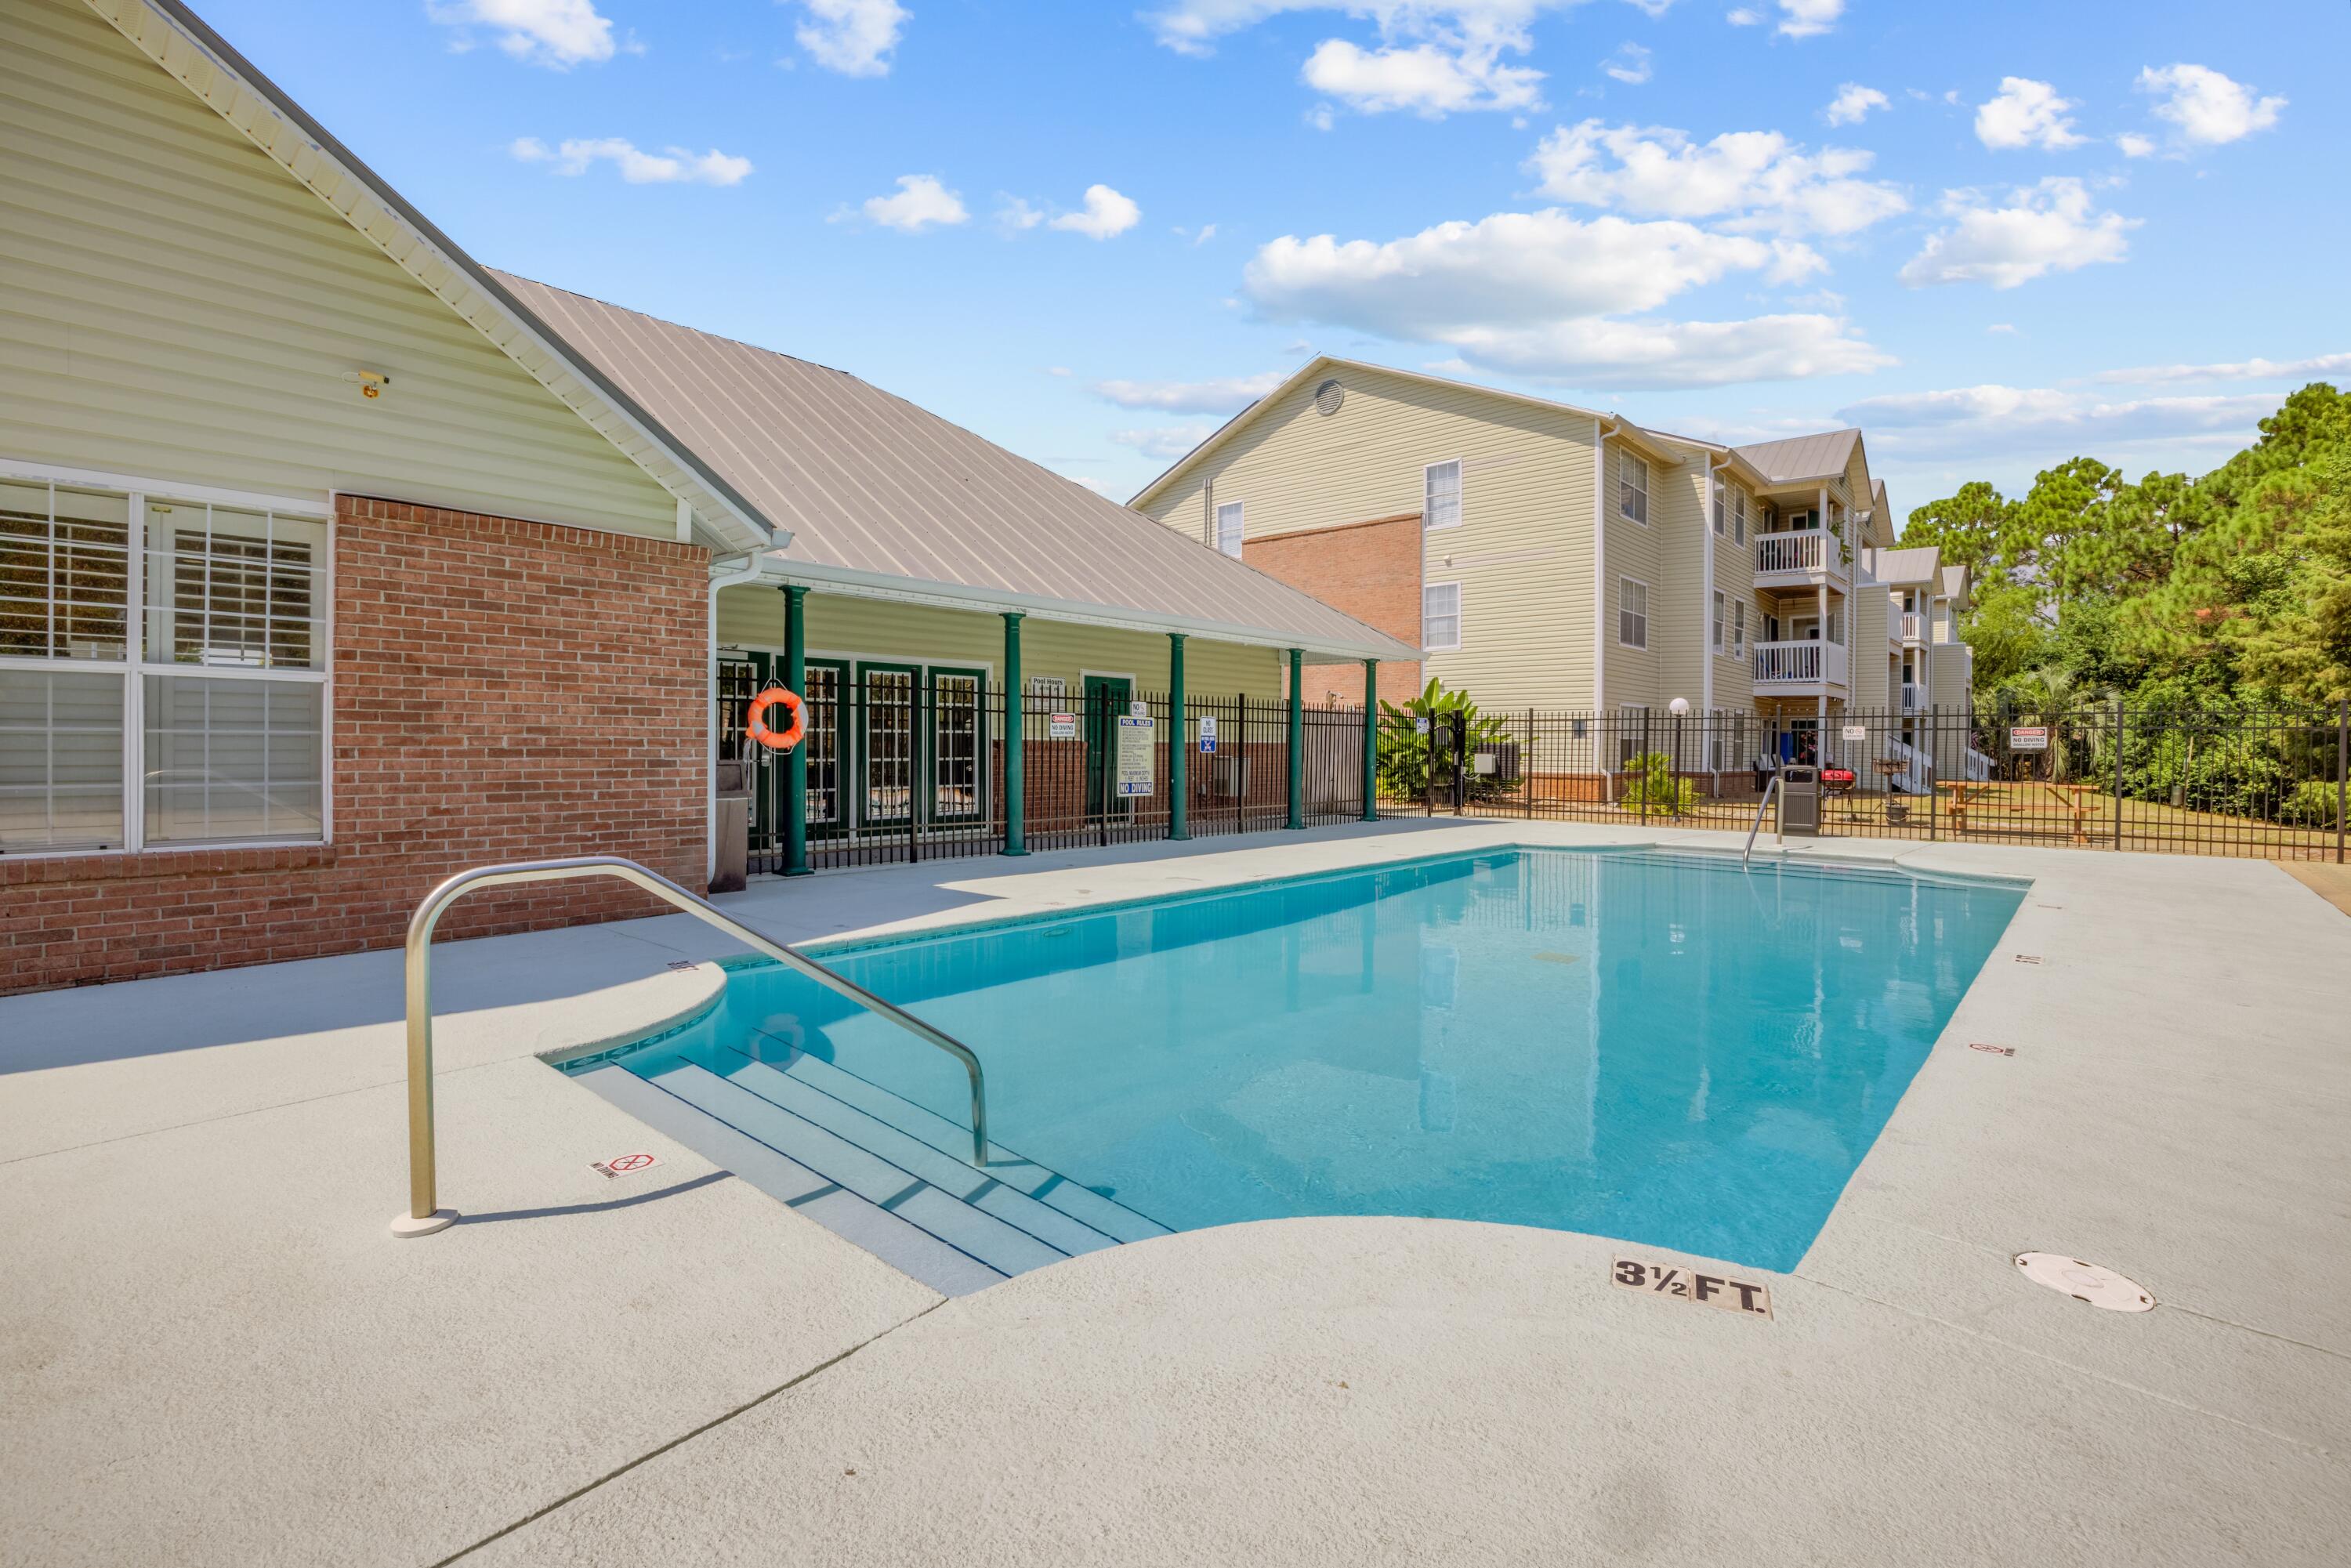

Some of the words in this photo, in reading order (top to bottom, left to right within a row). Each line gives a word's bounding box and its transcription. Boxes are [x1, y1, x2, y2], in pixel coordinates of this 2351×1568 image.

[1120, 784, 1129, 793] NO
[1132, 783, 1152, 793] DIVING
[1695, 1274, 1766, 1313] FT.
